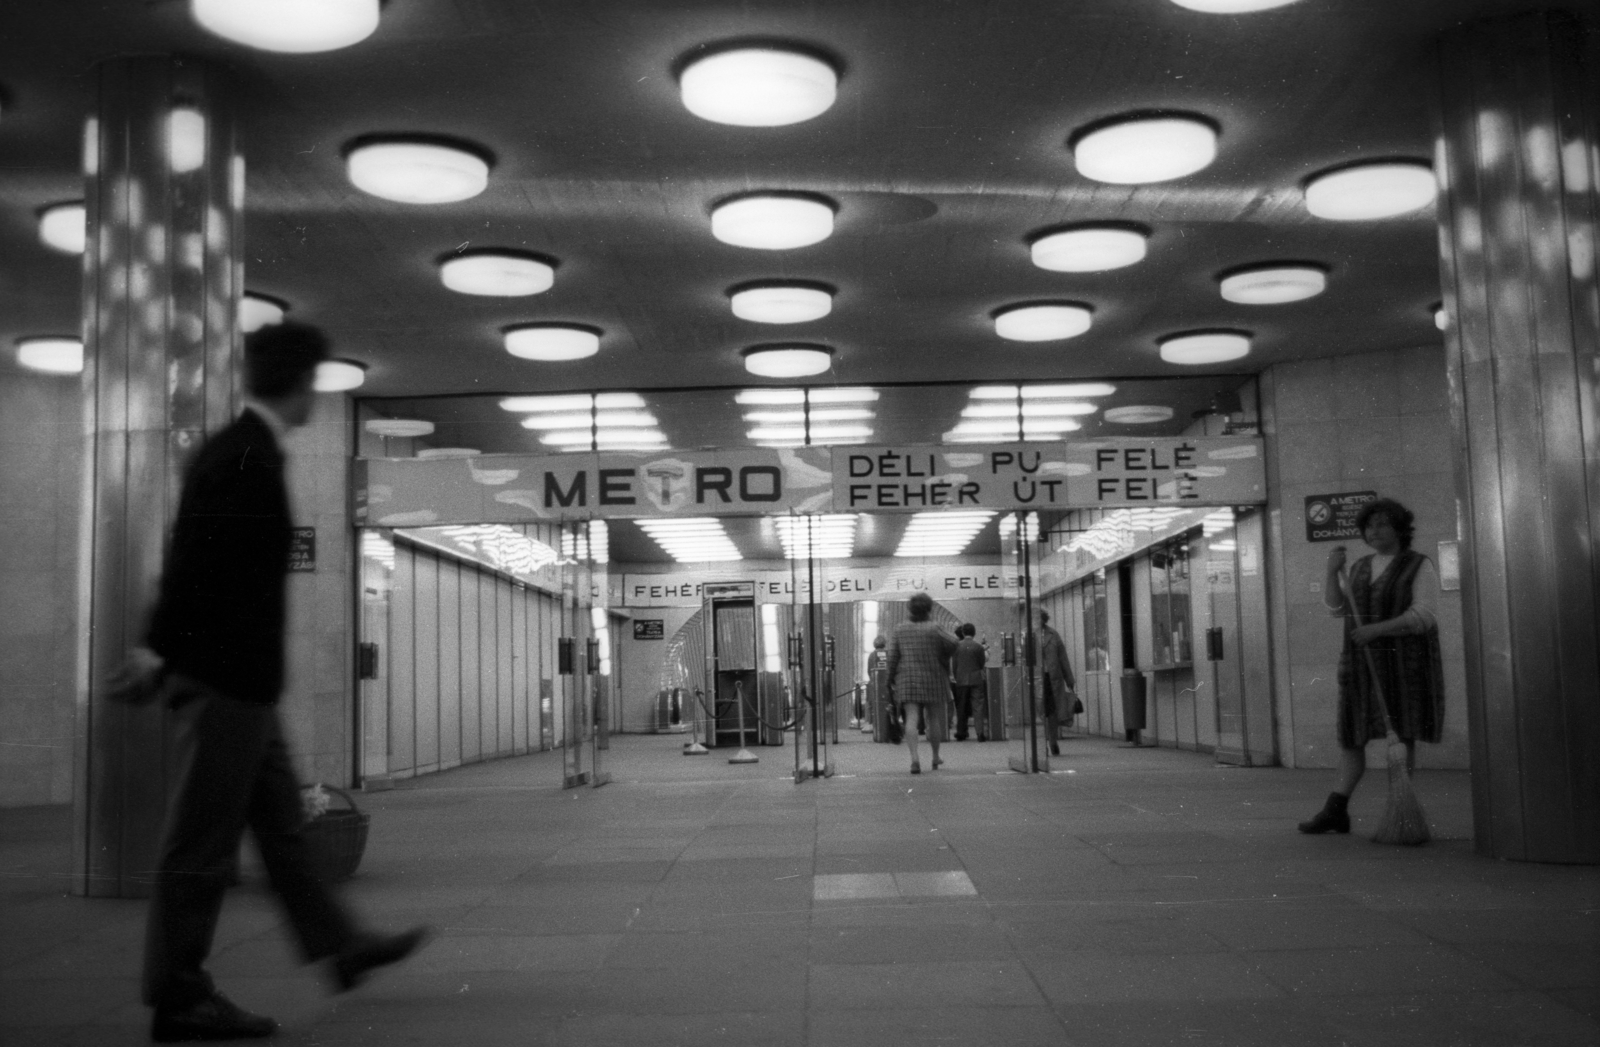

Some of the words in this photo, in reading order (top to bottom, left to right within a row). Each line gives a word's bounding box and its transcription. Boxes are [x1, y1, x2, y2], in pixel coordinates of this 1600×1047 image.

[849, 450, 935, 477] DÉLI
[1096, 442, 1197, 471] FELÉ
[544, 465, 782, 508] METRO
[850, 478, 981, 507] FEHÉR
[1098, 472, 1199, 500] FELÉ
[1339, 495, 1376, 504] METRO
[757, 578, 810, 595] ELÉ
[944, 574, 999, 589] FELÉ
